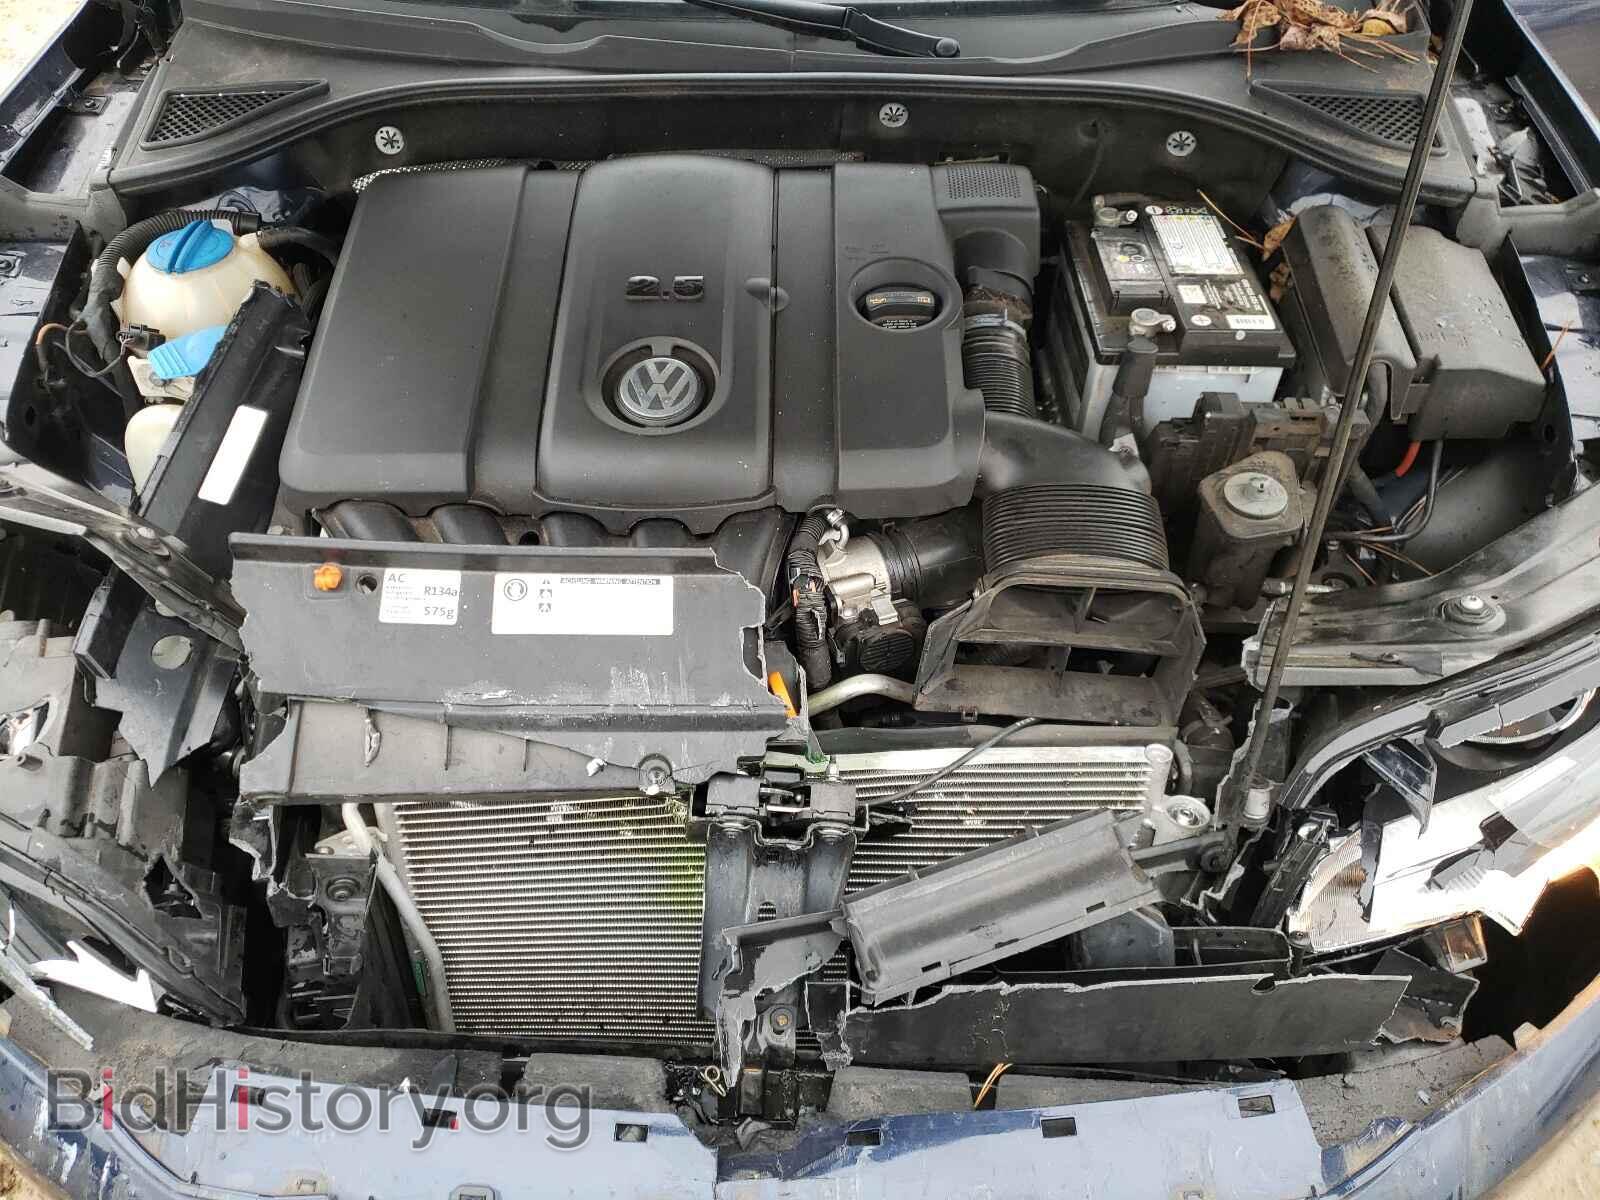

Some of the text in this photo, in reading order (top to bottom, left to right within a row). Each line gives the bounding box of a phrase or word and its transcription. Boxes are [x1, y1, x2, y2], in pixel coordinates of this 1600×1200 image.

[625, 275, 704, 301] 2.5
[622, 359, 697, 416] VW
[387, 573, 407, 583] AC
[424, 585, 458, 597] R134a
[424, 606, 455, 620] 575g
